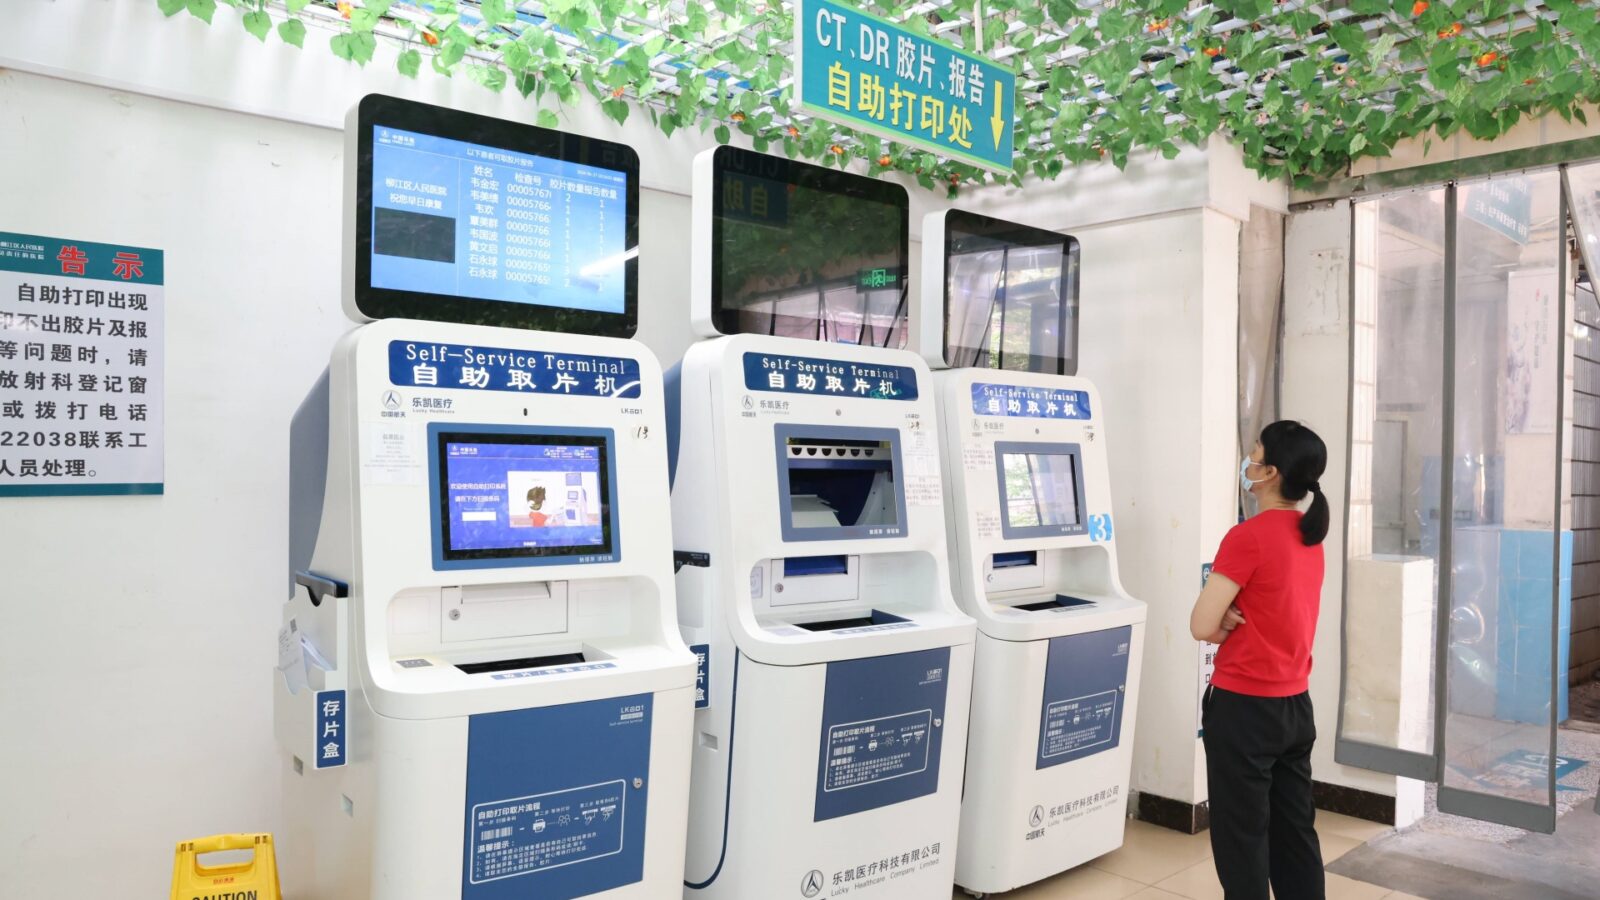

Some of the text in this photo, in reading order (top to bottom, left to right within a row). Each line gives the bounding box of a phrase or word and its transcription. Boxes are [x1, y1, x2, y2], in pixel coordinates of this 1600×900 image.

[816, 8, 985, 106] CT、DR 胶片、报告
[828, 60, 973, 149] 自助打印处
[474, 165, 493, 177] 姓名
[385, 177, 447, 197] 柳江区人民医院
[565, 193, 571, 202] 2
[57, 245, 144, 280] 告示
[18, 283, 148, 311] 自助打印出现
[0, 311, 147, 338] 印不出胶片及报
[0, 340, 147, 367] 等问题时，请
[544, 354, 625, 375] Terminal
[413, 363, 618, 396] 自助取片机
[763, 358, 900, 380] Self-Service Terminal
[0, 370, 147, 394] 放射科登记窗
[769, 371, 897, 396] 自助取片机
[412, 397, 452, 408] 乐凯医疗
[759, 399, 790, 410] 乐凯医疗
[984, 387, 1078, 402] Self-Service Terminal
[2, 400, 147, 422] 或拨打电话
[988, 399, 1077, 416] 自助取片机
[0, 430, 147, 449] 22038联系工
[0, 459, 97, 478] 人员处理。
[322, 700, 340, 759] 存片盒
[478, 802, 541, 820] 自助打印取片流程
[1049, 785, 1119, 819] 乐凯医疗科技有限公司
[832, 842, 941, 886] 乐凯医疗科技有限公司
[831, 857, 940, 897] Lucky Healthcare Company Limited
